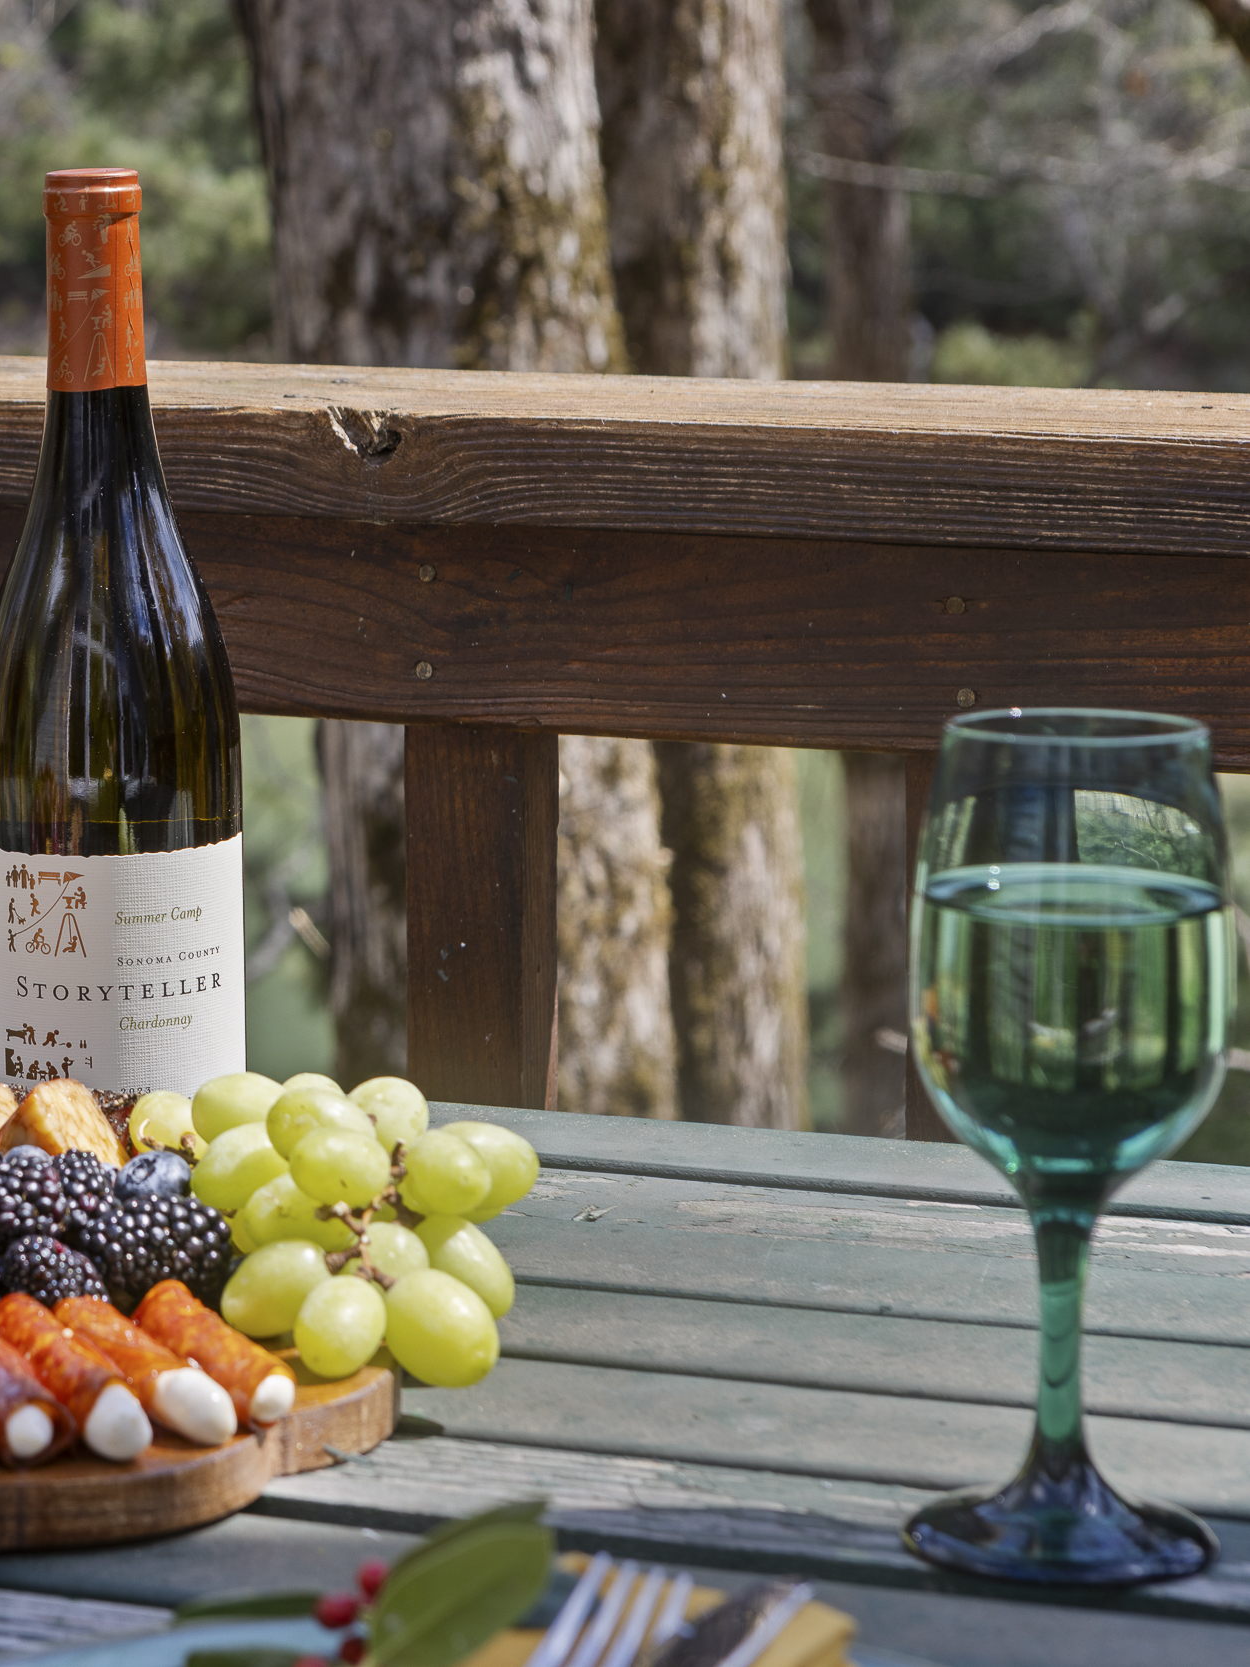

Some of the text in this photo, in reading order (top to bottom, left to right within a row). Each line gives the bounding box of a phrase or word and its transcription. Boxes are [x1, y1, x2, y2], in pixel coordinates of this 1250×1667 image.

[114, 906, 202, 926] Summer Camp
[117, 946, 220, 967] SONOMA COUNTY
[16, 972, 222, 1002] STORYTELLER
[119, 1014, 193, 1031] Chardonnay
